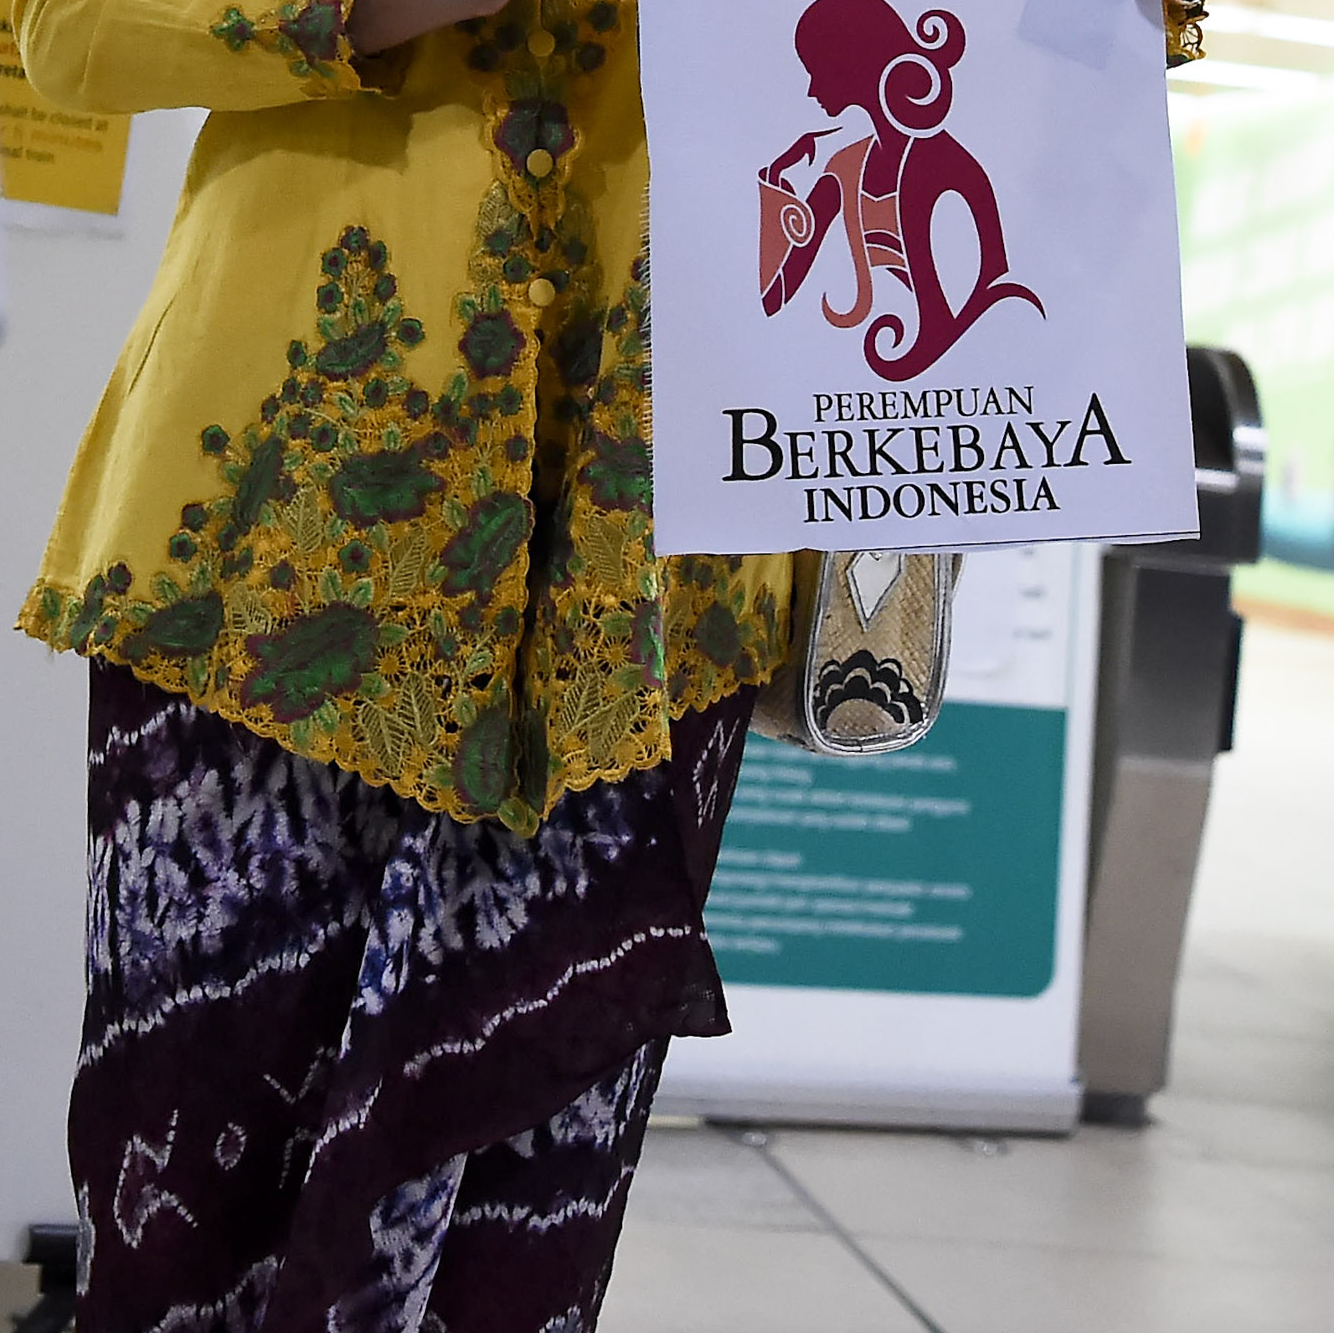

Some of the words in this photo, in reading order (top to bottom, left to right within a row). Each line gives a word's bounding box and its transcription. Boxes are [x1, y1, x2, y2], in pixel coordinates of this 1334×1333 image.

[813, 386, 1035, 423] PEREMPUAN
[721, 391, 1133, 482] BERKEBAYA
[802, 475, 1061, 523] INDONESIA
